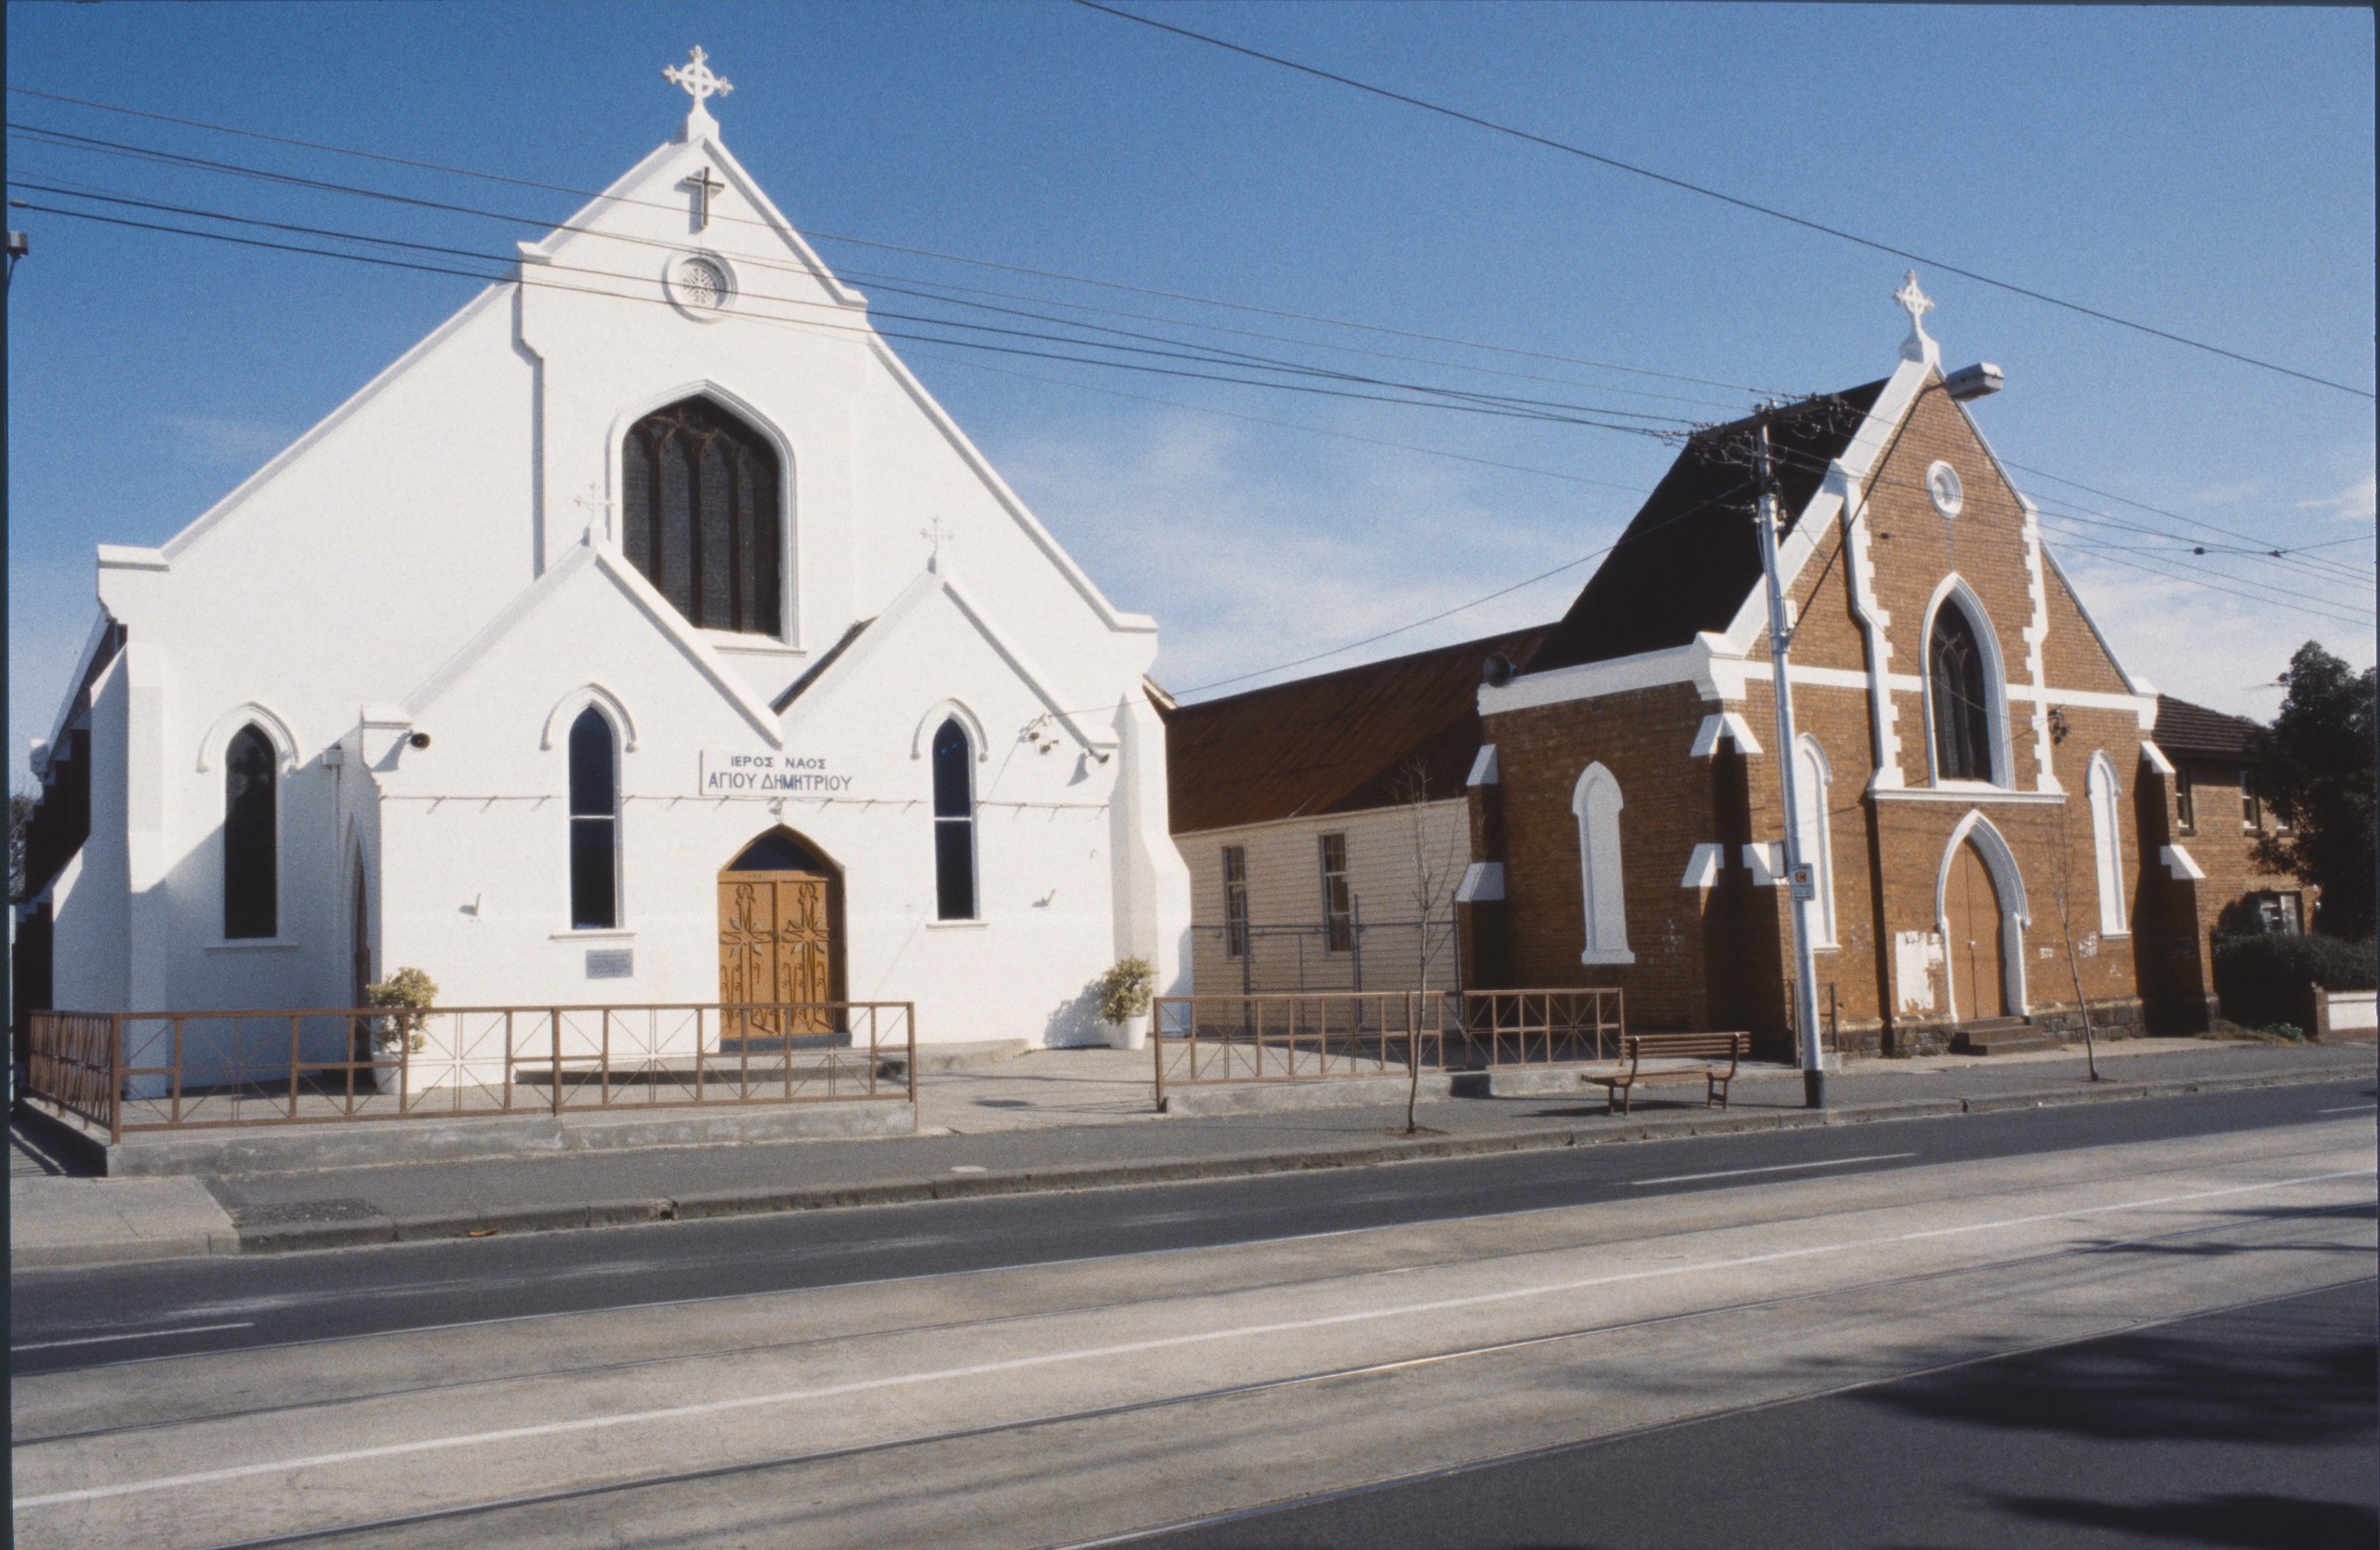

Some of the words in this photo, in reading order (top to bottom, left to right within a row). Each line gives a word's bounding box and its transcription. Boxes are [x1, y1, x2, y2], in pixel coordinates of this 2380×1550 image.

[732, 756, 774, 768] ΙΕΡΟΣ
[786, 758, 826, 770] ΝΑΟΣ
[708, 773, 757, 788] ΑΓΙΟΥ
[760, 774, 853, 790] ΔΗΜΗΤΡΙΟΥ
